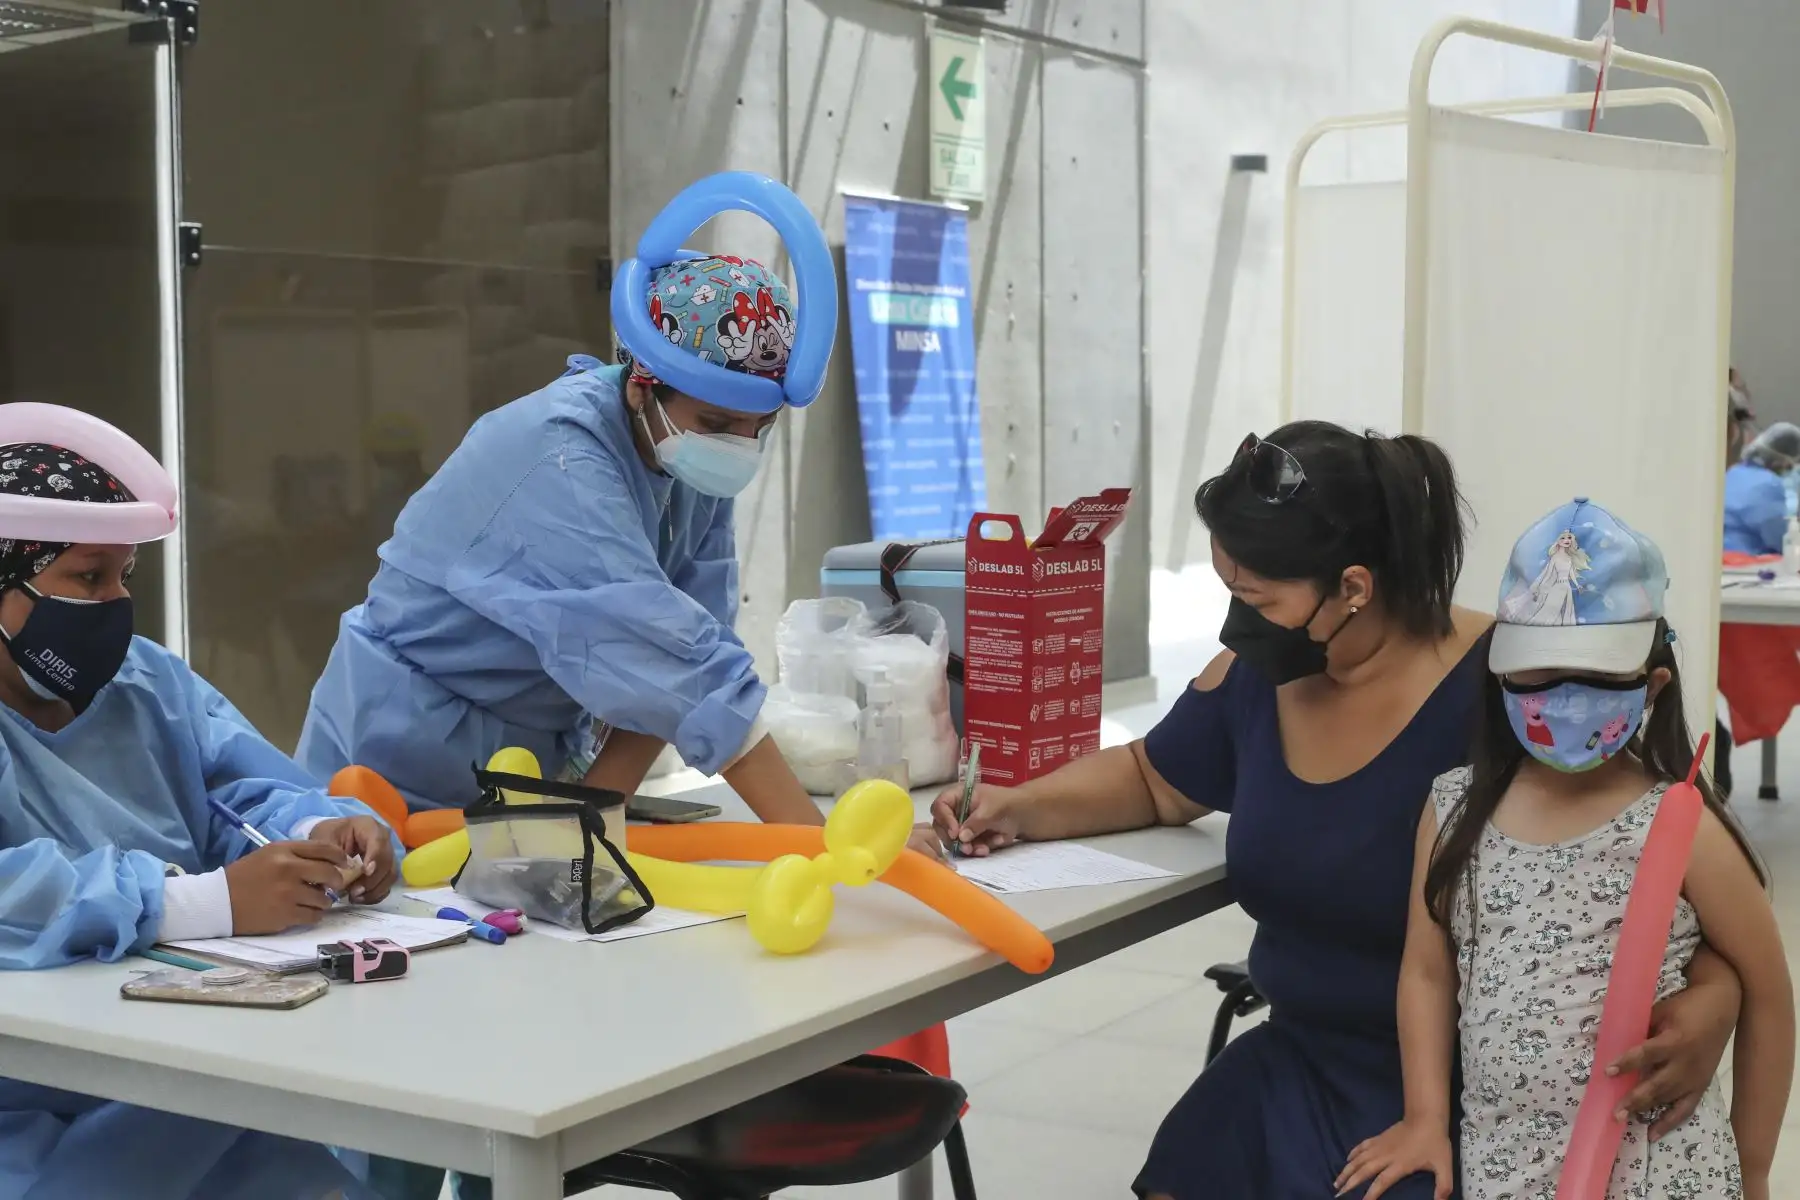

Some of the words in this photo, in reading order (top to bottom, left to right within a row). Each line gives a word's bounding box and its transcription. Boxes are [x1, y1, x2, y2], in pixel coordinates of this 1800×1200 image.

[1081, 503, 1125, 512] DESLAB
[978, 561, 1014, 574] DESLAB
[1015, 565, 1025, 576] 5L
[1046, 559, 1090, 576] DESLAB
[1091, 558, 1103, 572] 5L
[24, 648, 45, 670] Lima
[46, 667, 75, 691] Centro
[40, 648, 77, 679] DIRIS
